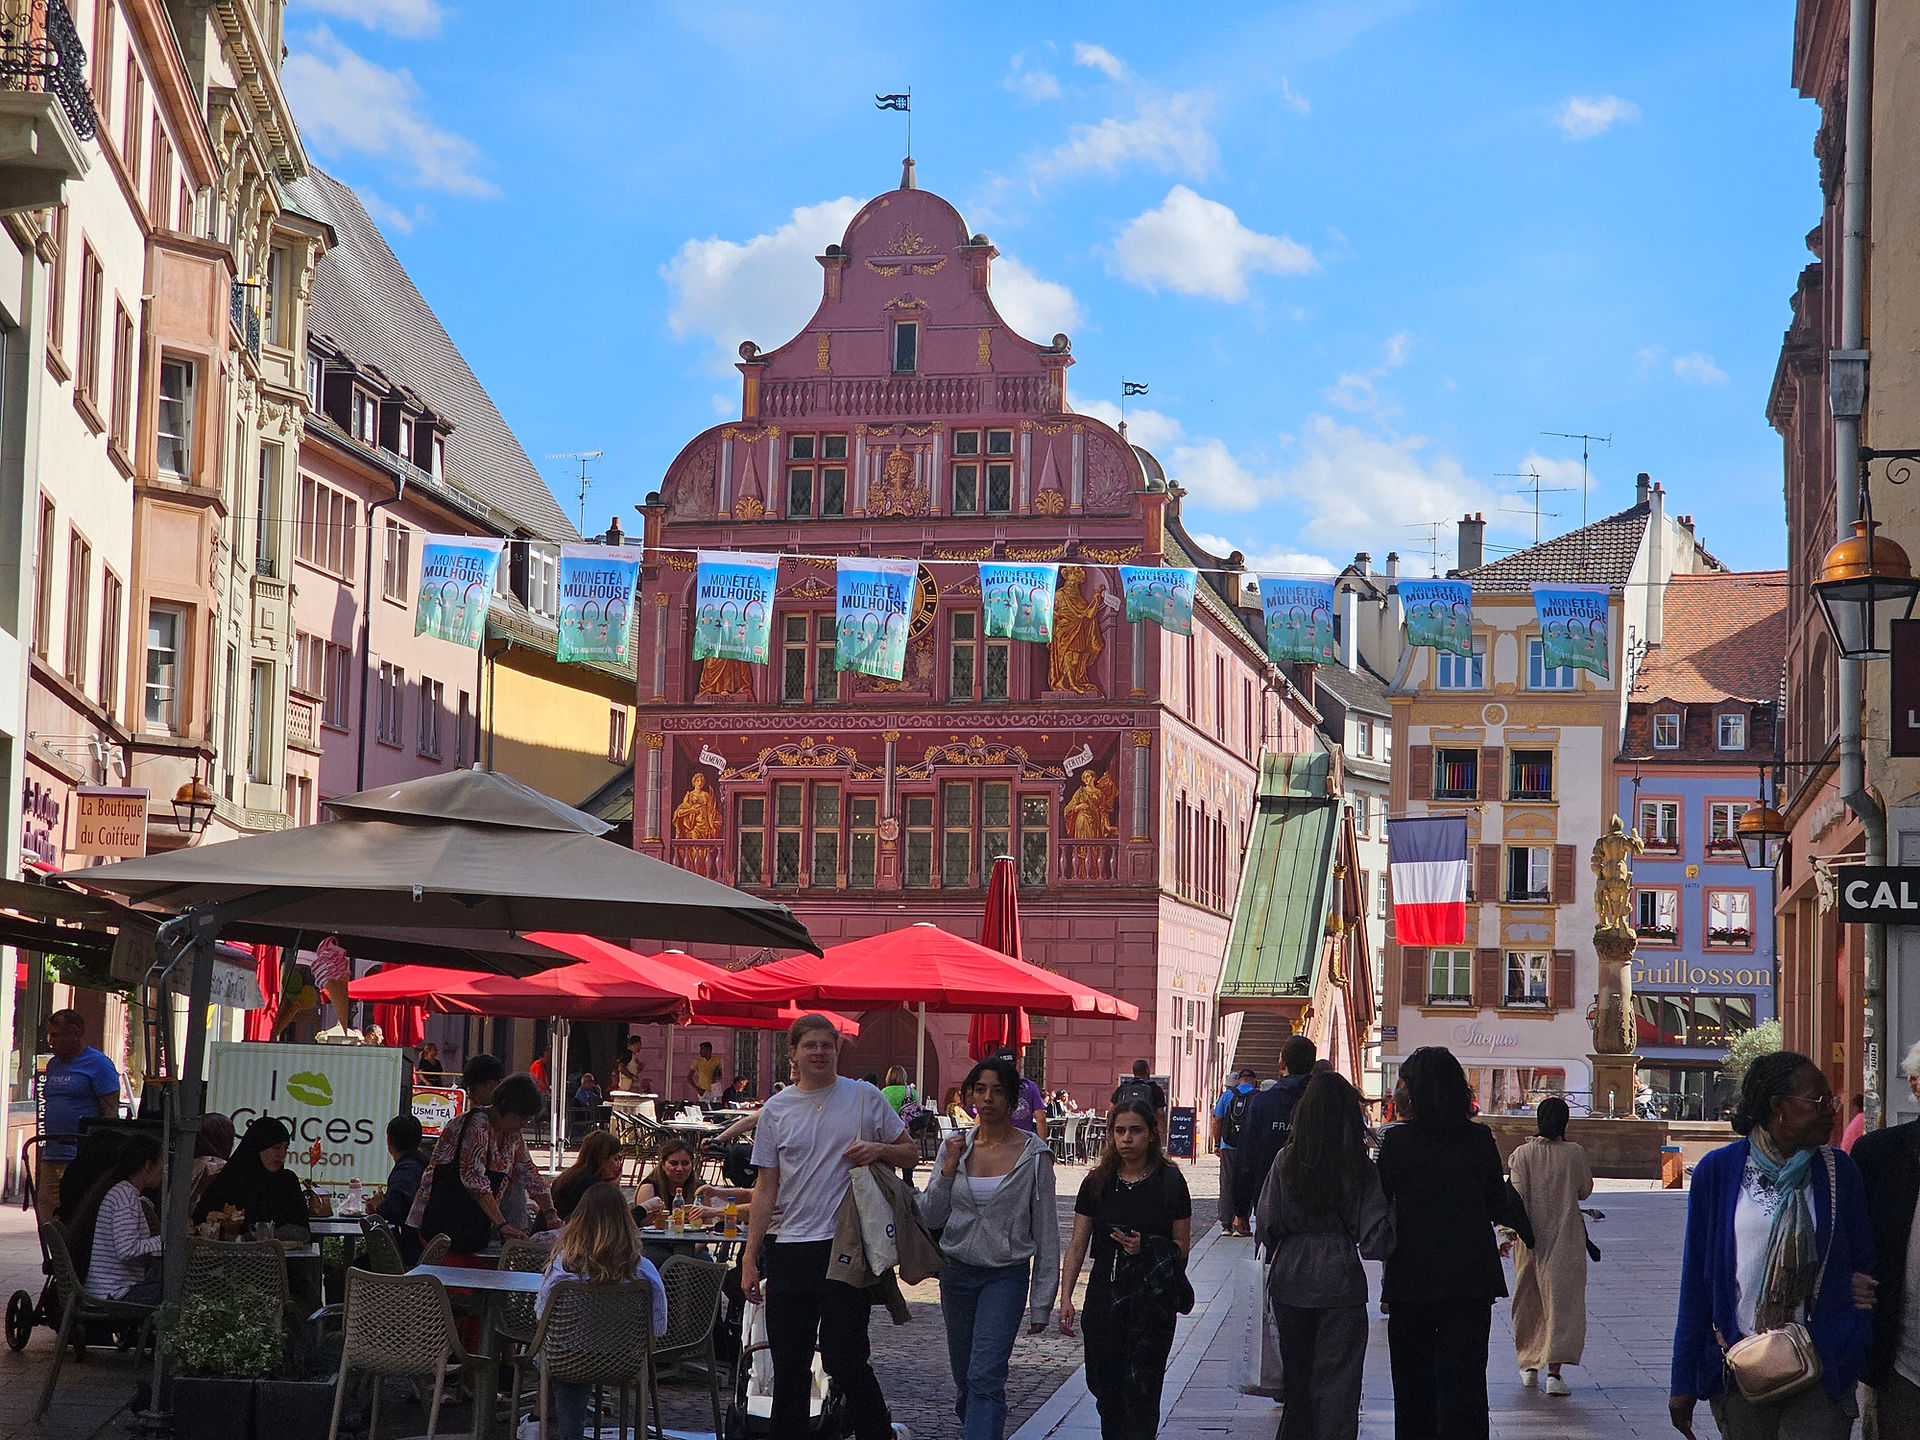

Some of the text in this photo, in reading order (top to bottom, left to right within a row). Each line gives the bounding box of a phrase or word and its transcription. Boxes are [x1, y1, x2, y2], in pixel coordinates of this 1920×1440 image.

[423, 566, 491, 588] MULHOUSE
[985, 576, 1052, 592] MULHOUSE
[1127, 576, 1192, 591] MULHOUSE
[563, 584, 630, 600] MULHOUSE
[701, 585, 768, 604] MULHOUSE
[1405, 592, 1469, 608] MULHOUSE
[842, 595, 907, 615] MULHOUSE
[1266, 594, 1331, 613] MULHOUSE
[1542, 607, 1607, 624] MULHOUSE
[1065, 753, 1090, 769] VERITAS
[81, 797, 92, 816] La
[98, 797, 143, 822] Boutique
[81, 825, 140, 846] du Coiffeur
[1844, 880, 1918, 909] CAL
[1631, 958, 1771, 987] Guillosson
[1450, 1021, 1518, 1054] Jacques
[270, 1069, 277, 1101] I
[412, 1106, 451, 1119] USMI TEA
[229, 1107, 374, 1145] Gaces
[286, 1149, 355, 1167] mason
